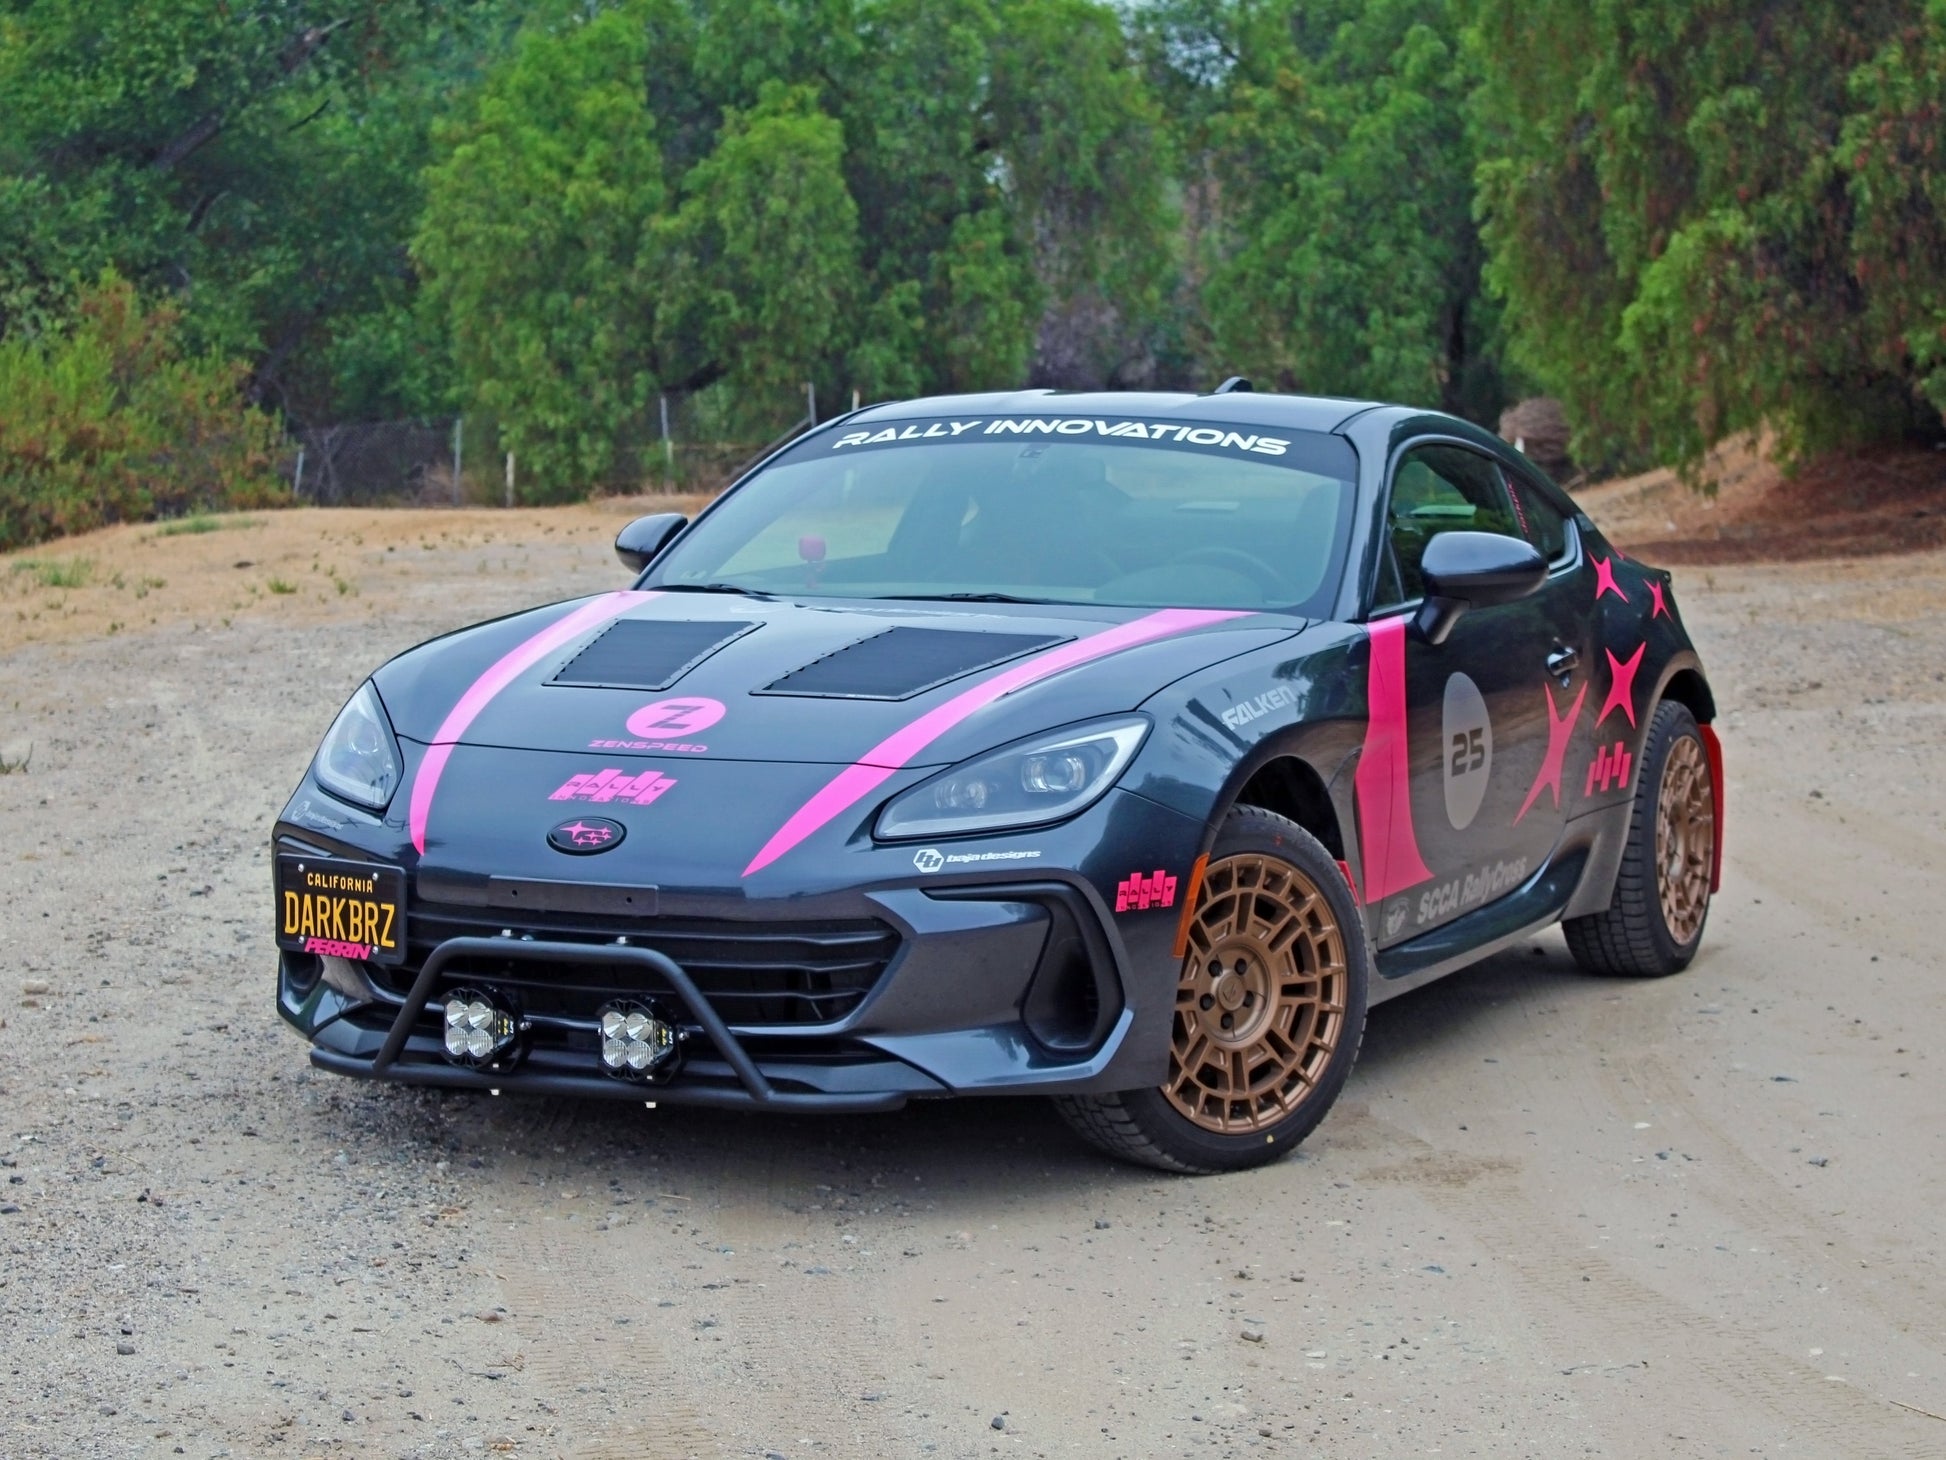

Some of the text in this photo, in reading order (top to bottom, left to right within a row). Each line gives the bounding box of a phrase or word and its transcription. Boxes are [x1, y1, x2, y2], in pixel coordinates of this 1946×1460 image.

[832, 418, 1292, 456] RALLY INNOVATIONS
[646, 704, 706, 730] Z
[1221, 685, 1299, 731] FALKEN
[587, 738, 709, 753] ZENSPEED
[1451, 727, 1486, 778] 25
[566, 781, 664, 792] RALLY
[980, 850, 1042, 860] designs
[307, 872, 374, 893] CALIFORNIA
[1119, 885, 1174, 897] RALLY
[1416, 879, 1460, 925] SCCA
[284, 890, 396, 948] DARKBRZ
[304, 937, 372, 961] PERRIN
